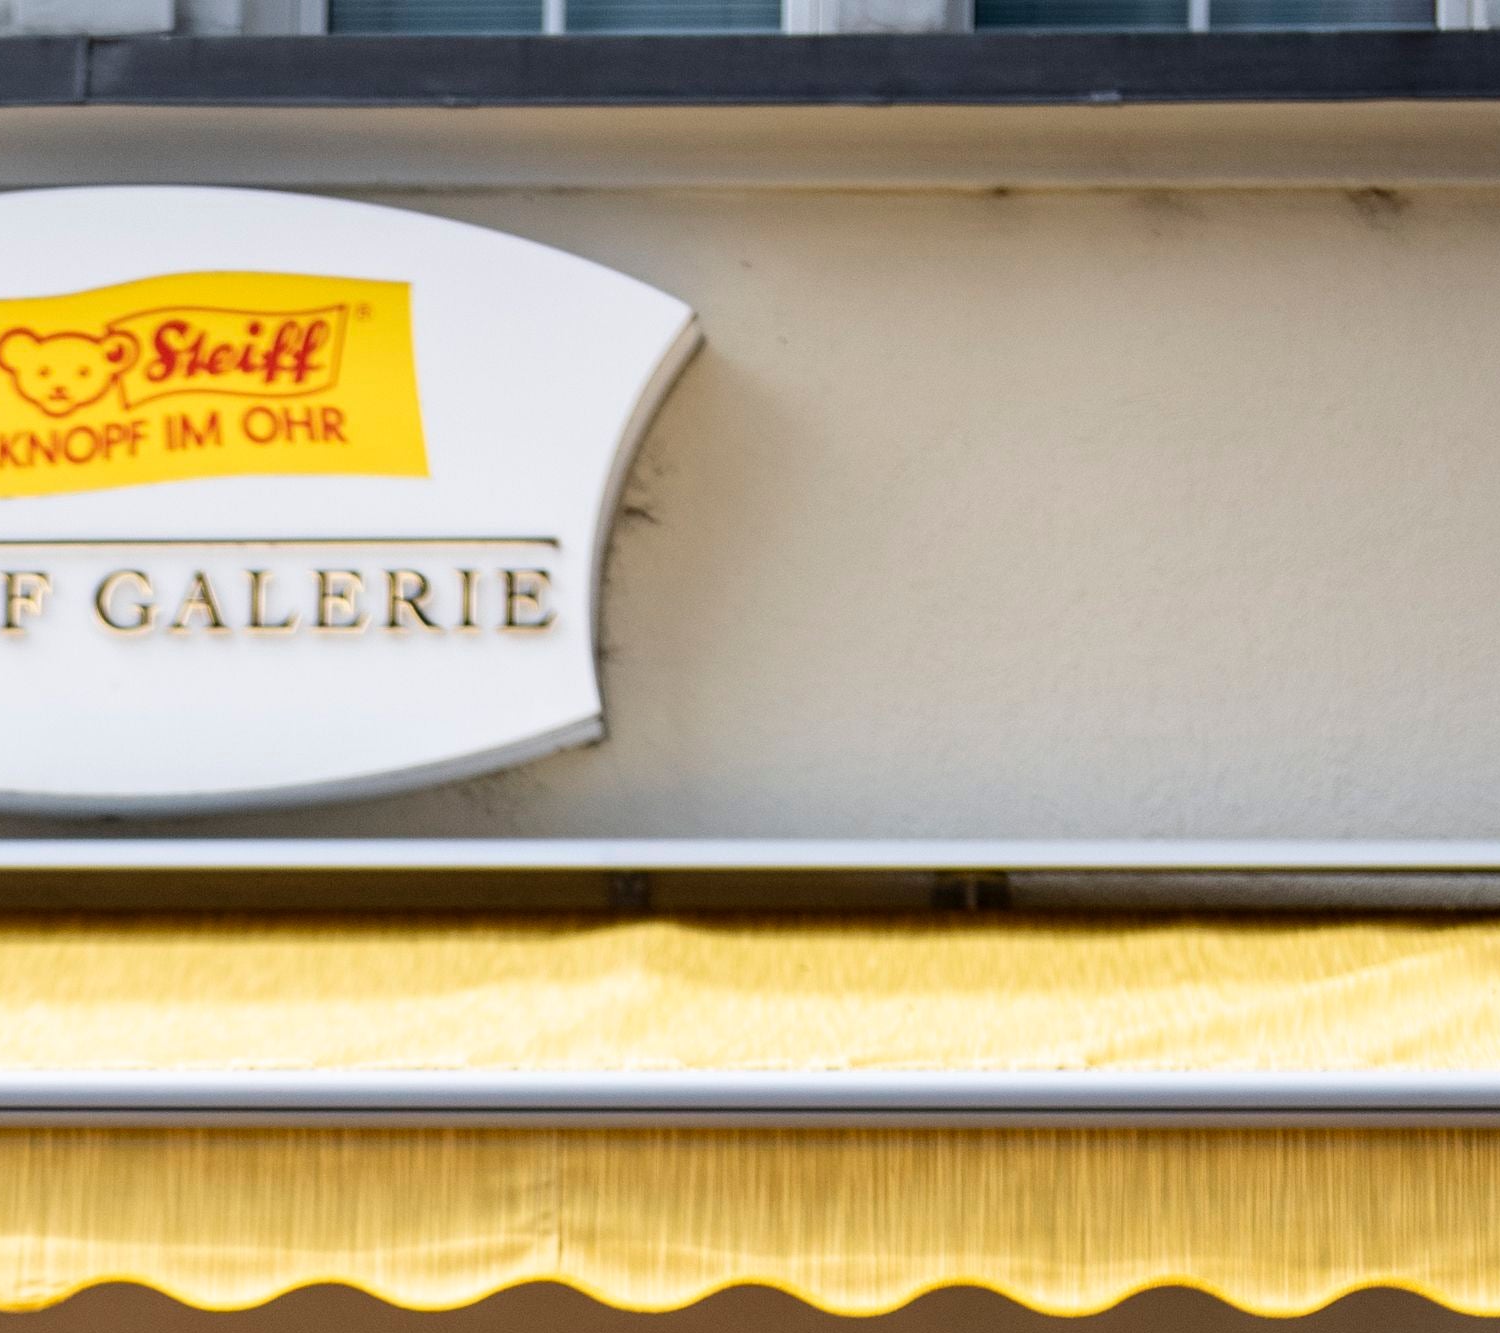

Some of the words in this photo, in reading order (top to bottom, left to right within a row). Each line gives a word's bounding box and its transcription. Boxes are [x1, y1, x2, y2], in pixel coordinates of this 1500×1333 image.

[145, 320, 330, 384] Steiff
[165, 410, 222, 450] IM
[242, 404, 347, 444] OHR
[93, 568, 558, 635] GALERIE
